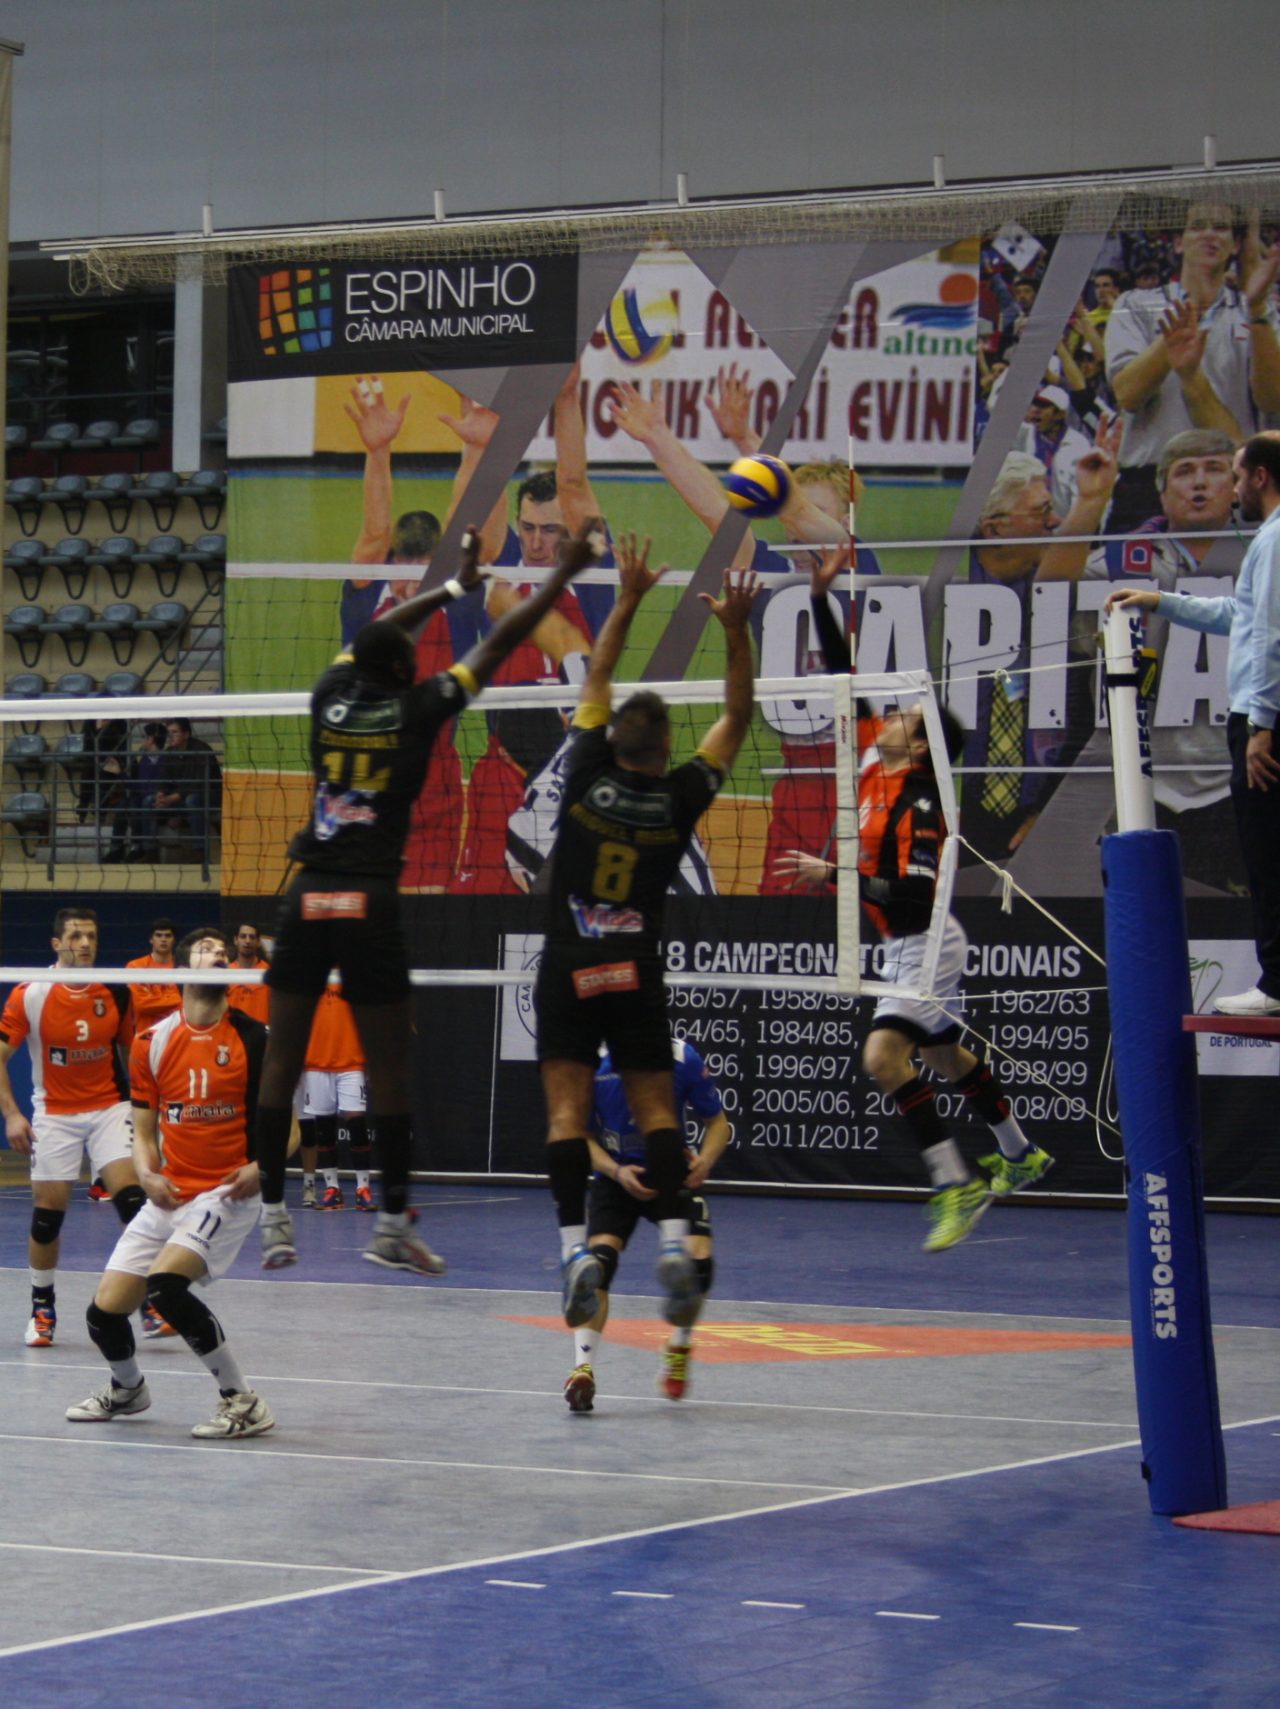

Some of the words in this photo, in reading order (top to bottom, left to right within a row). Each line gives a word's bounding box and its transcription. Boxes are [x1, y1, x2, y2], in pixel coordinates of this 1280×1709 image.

[346, 262, 536, 315] ESPINHO
[345, 317, 427, 343] CÂMARA
[430, 313, 535, 338] MUNICIPAL
[592, 841, 639, 902] 8
[657, 941, 686, 972] 8
[988, 990, 1091, 1015] 1962/63
[75, 1019, 89, 1042] 3
[756, 1020, 859, 1049] 1984/85,
[988, 1025, 1090, 1050] 1994/95
[1210, 1036, 1222, 1048] DE
[189, 1068, 209, 1099] 11
[755, 1054, 857, 1084] 1996/97,
[751, 1088, 855, 1119] 2005/06,
[751, 1123, 880, 1151] 2011/2012
[1145, 1172, 1179, 1340] AFFSPORTS
